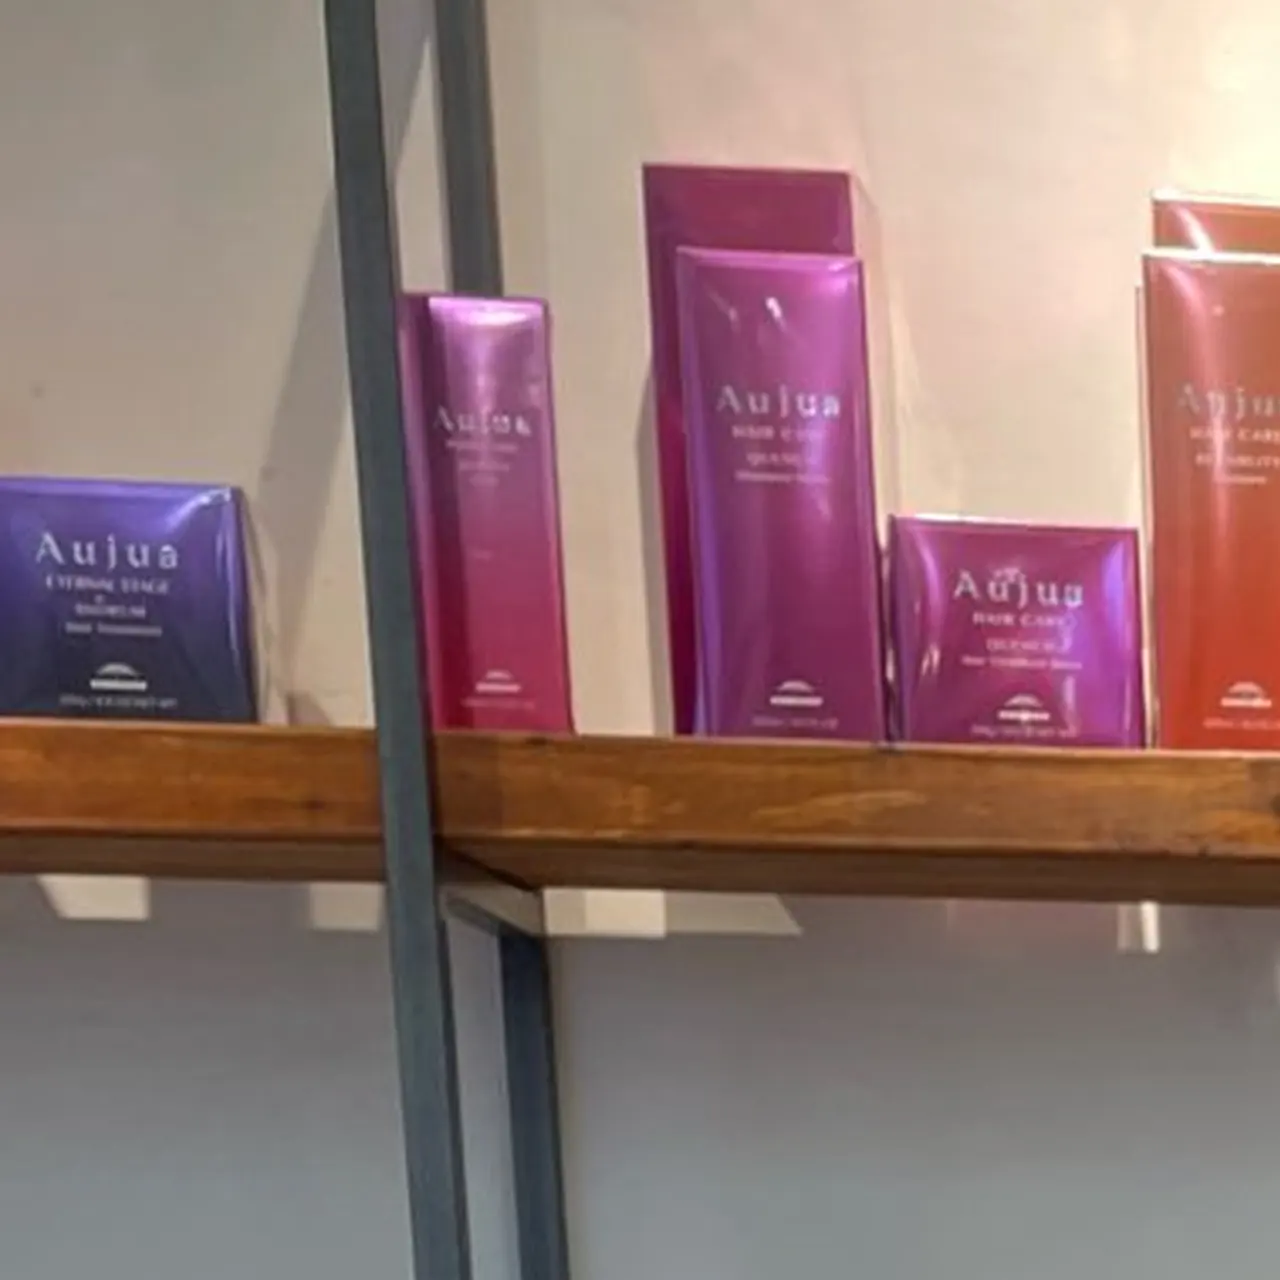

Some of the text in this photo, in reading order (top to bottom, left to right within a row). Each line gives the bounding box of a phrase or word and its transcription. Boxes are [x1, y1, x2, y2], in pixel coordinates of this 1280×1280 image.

[716, 384, 840, 418] Aujua
[35, 531, 179, 571] Aujua
[953, 568, 1084, 609] Aujua
